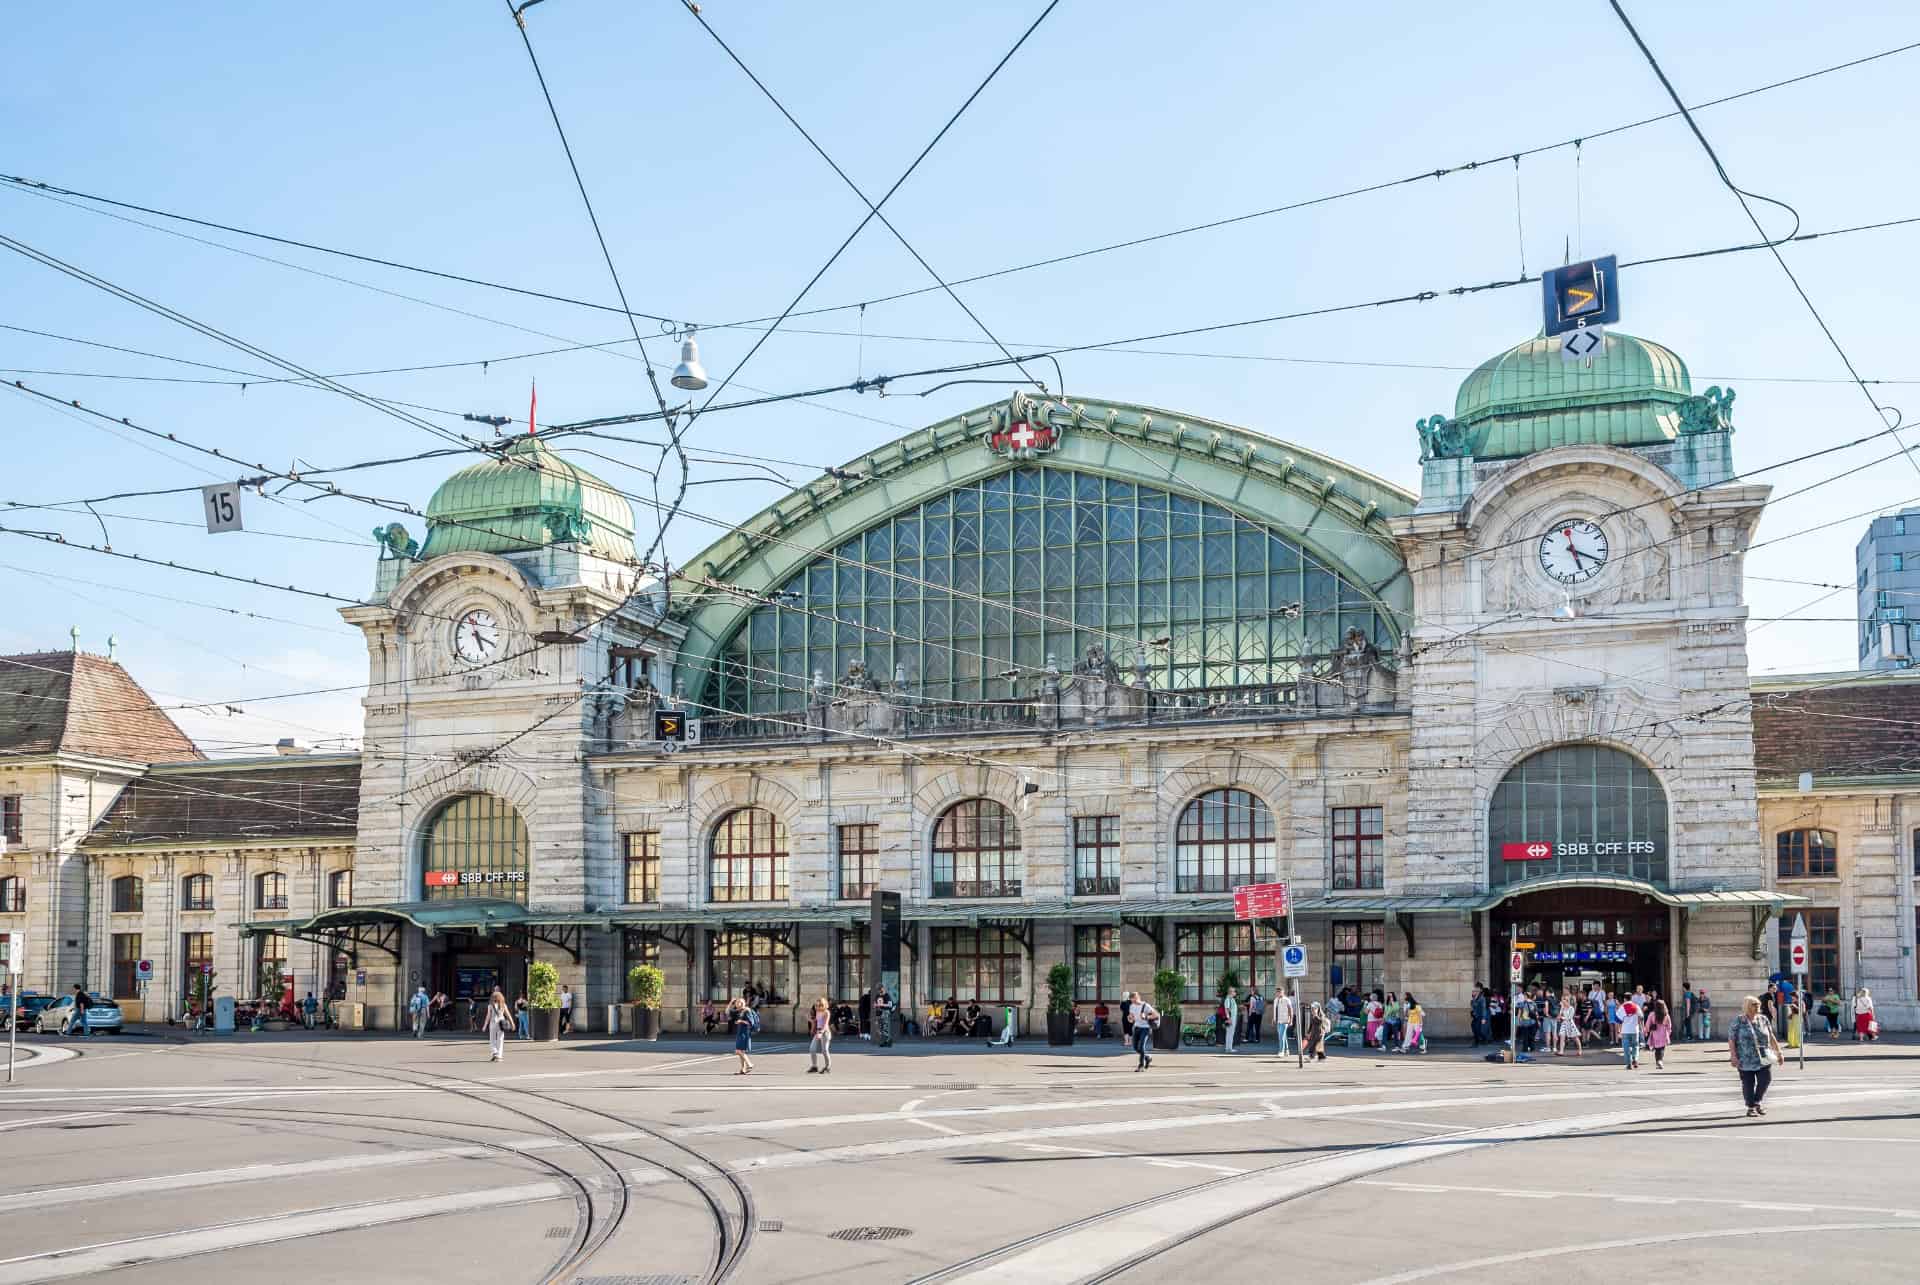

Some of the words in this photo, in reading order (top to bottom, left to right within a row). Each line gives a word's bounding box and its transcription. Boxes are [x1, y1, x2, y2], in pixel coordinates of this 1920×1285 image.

[1577, 317, 1587, 329] 5
[210, 492, 234, 524] 15
[688, 724, 697, 740] 5
[1557, 842, 1589, 856] SBB
[1595, 842, 1622, 855] CFF
[1627, 841, 1655, 854] FFS
[461, 872, 482, 883] SBB
[486, 872, 504, 882] CFF
[507, 871, 525, 881] FFS
